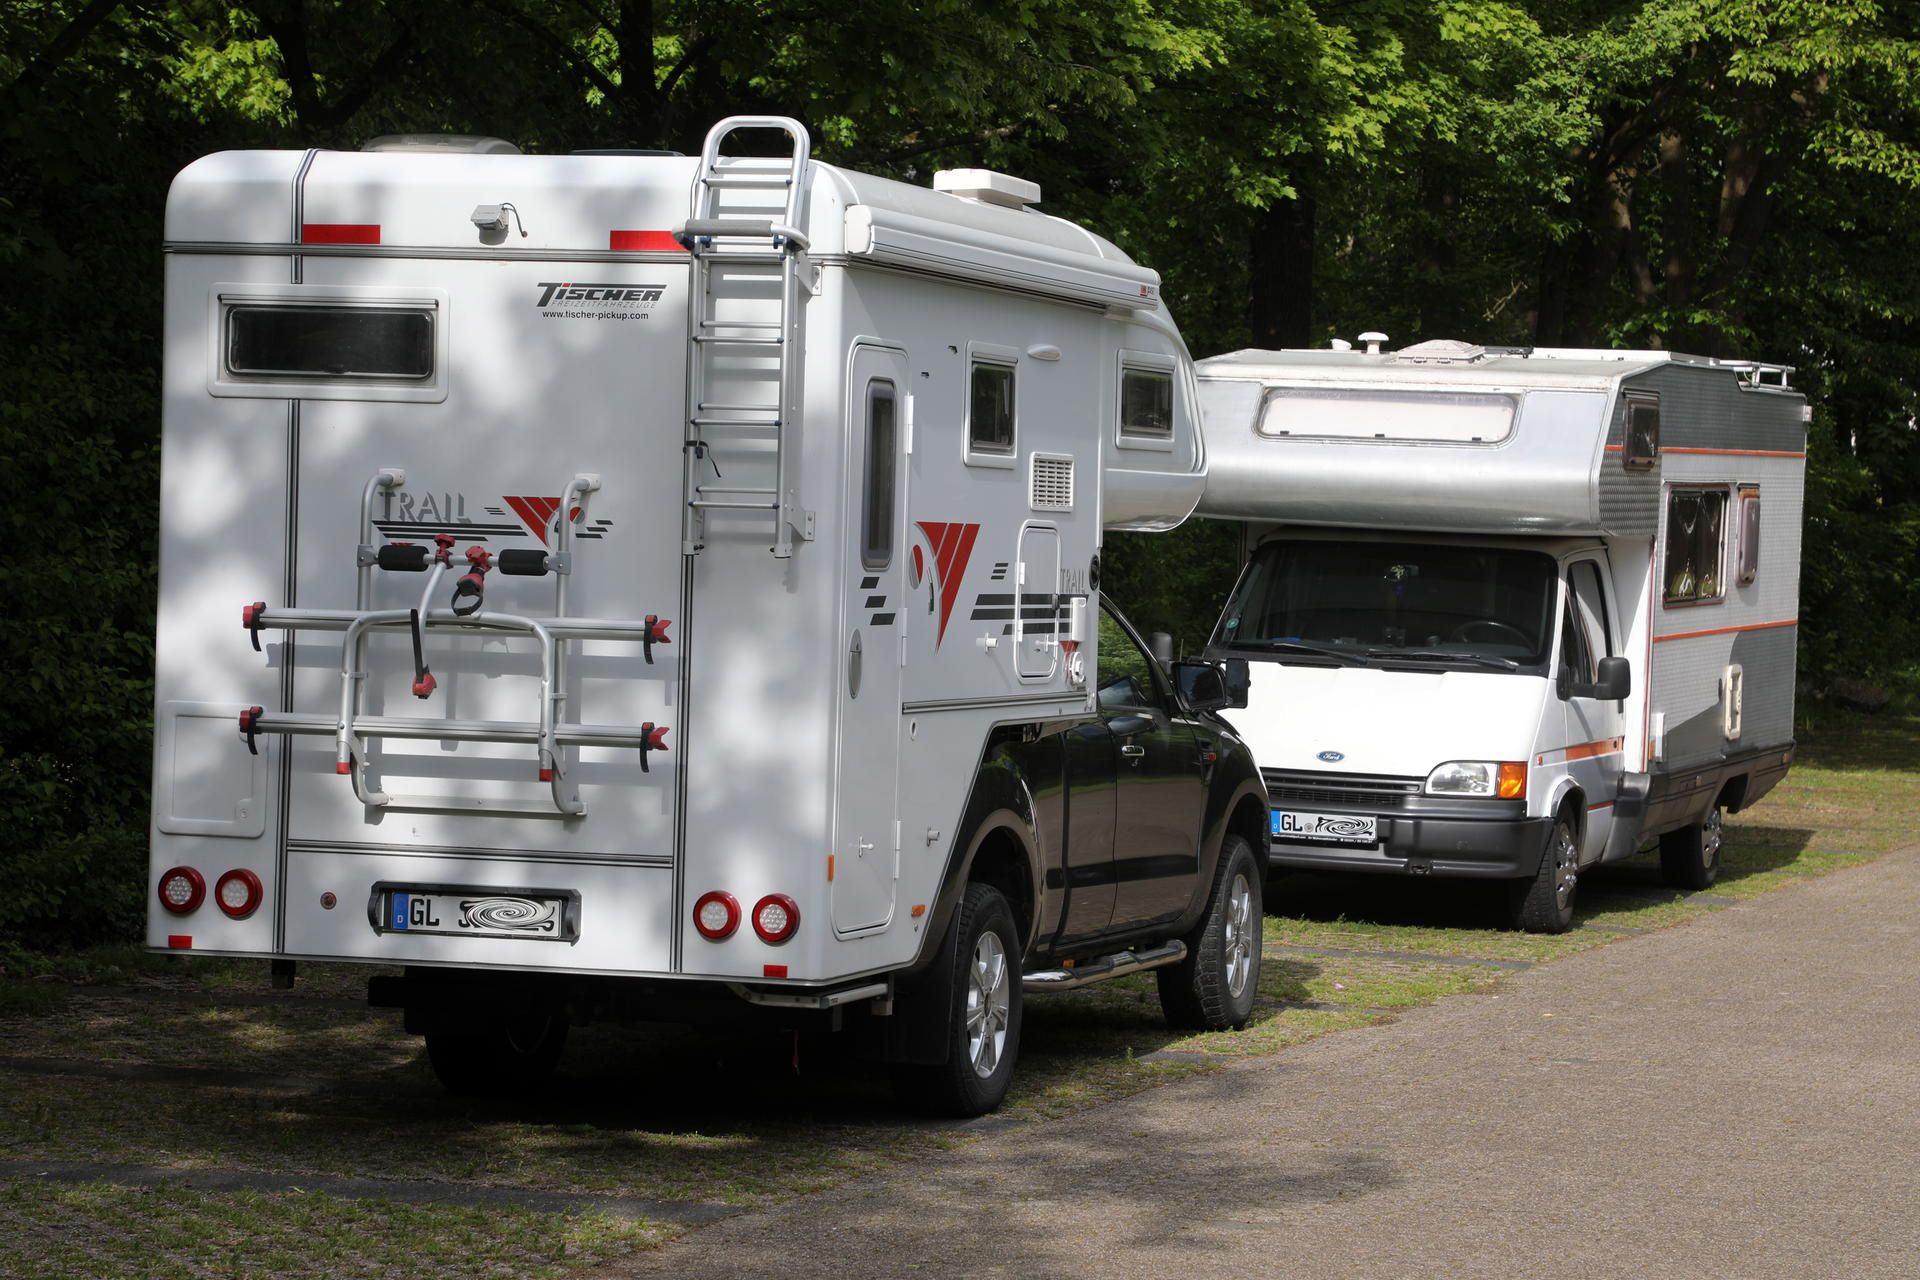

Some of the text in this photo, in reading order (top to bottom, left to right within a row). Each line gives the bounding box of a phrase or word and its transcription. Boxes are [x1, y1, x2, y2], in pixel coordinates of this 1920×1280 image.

[552, 300, 657, 309] FREIZEITFAHRZEUGE
[542, 310, 649, 321] www.tischer-pickup.com
[378, 490, 473, 525] TRAIL
[1281, 814, 1303, 832] GL
[397, 915, 403, 923] D
[410, 898, 440, 927] GL
